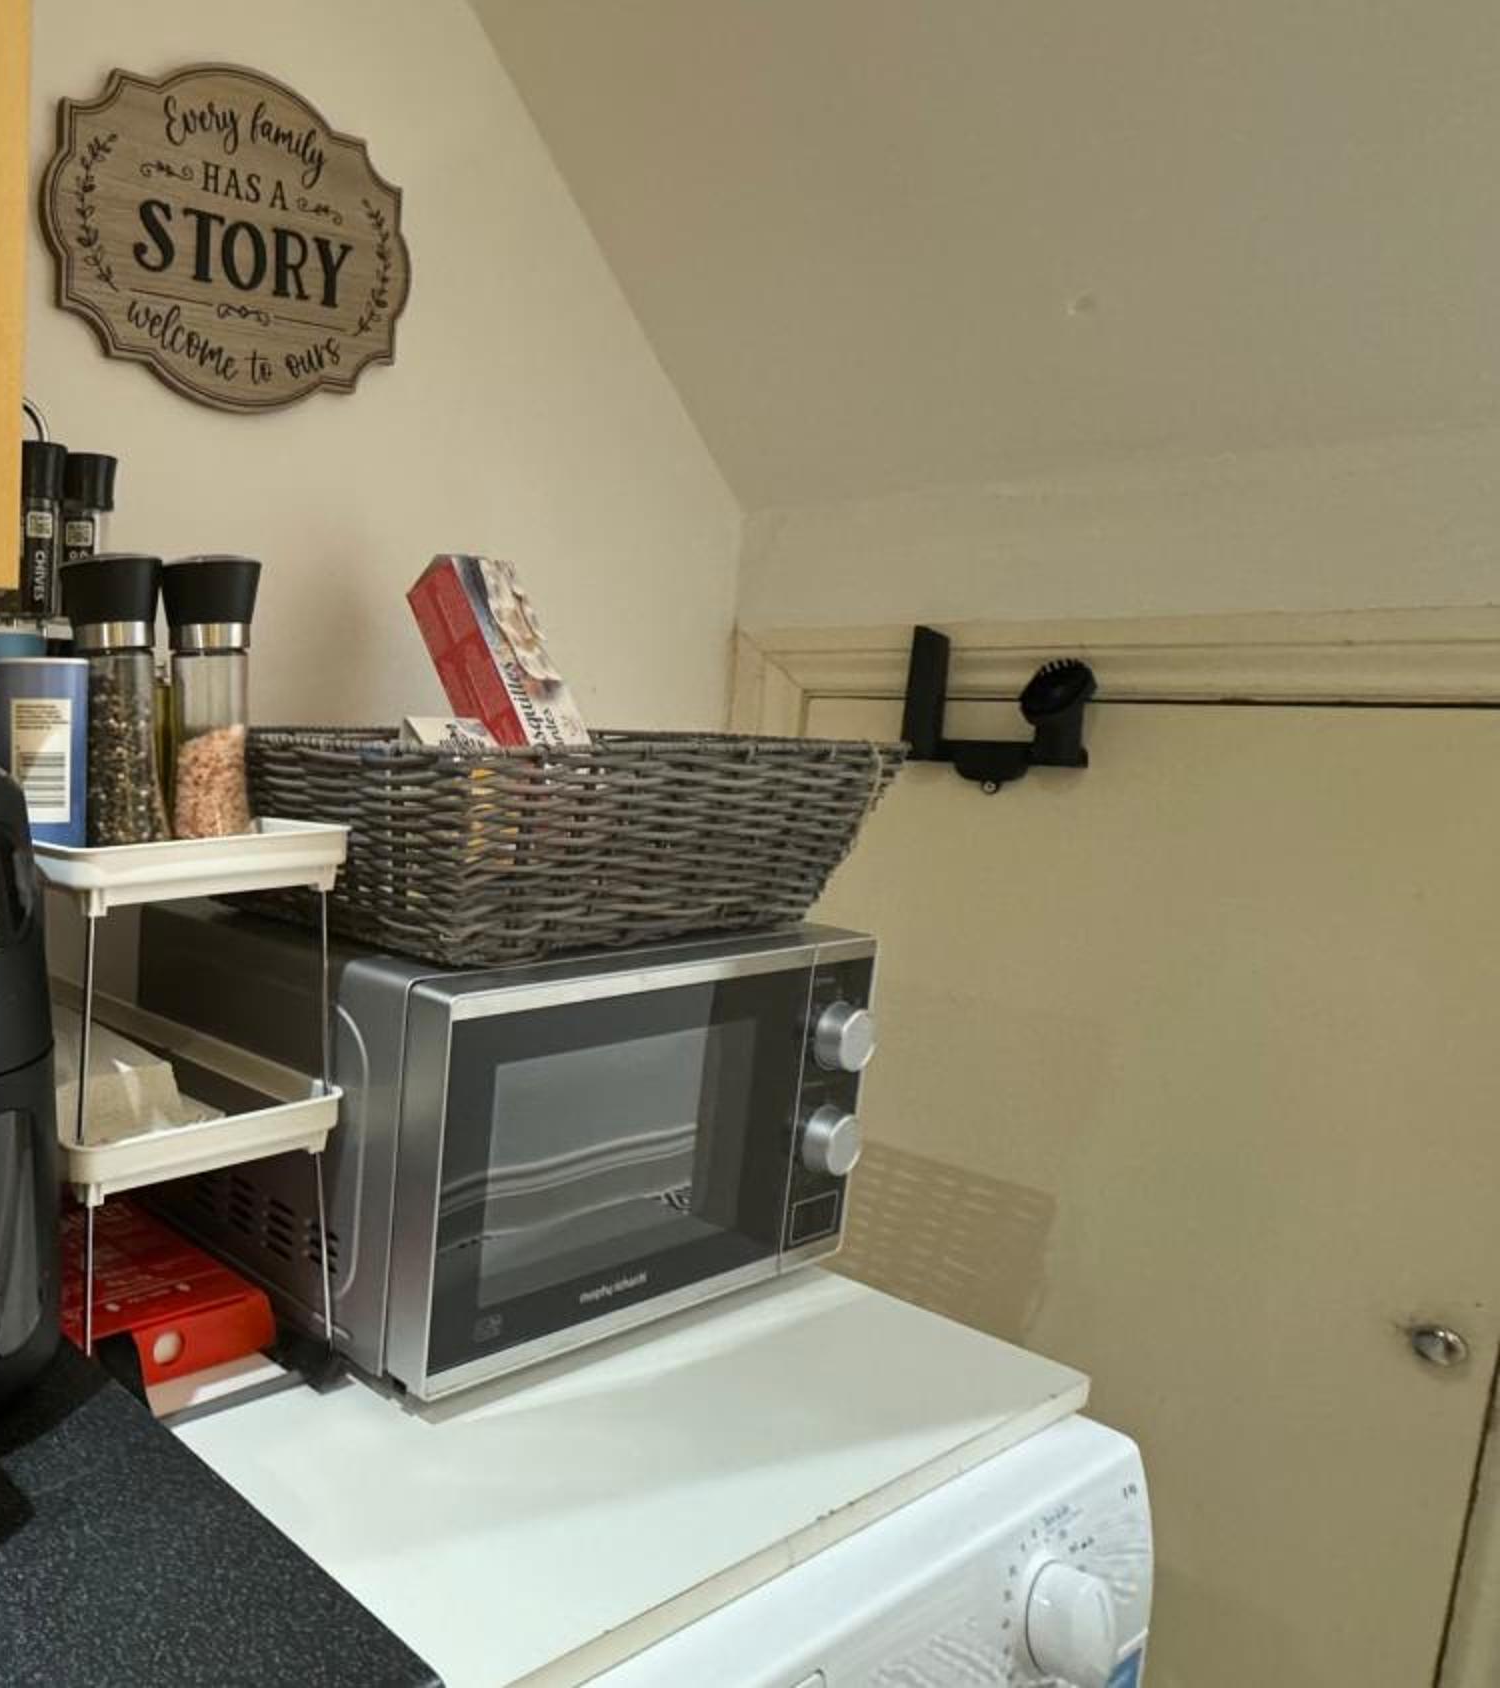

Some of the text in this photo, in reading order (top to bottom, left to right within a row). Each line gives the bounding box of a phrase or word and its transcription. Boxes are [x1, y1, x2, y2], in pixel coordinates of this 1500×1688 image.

[163, 95, 326, 190] Every family
[202, 160, 289, 211] HAS A
[132, 198, 354, 309] STORY
[127, 300, 341, 385] welcome to ours
[33, 550, 46, 601] CHIVES
